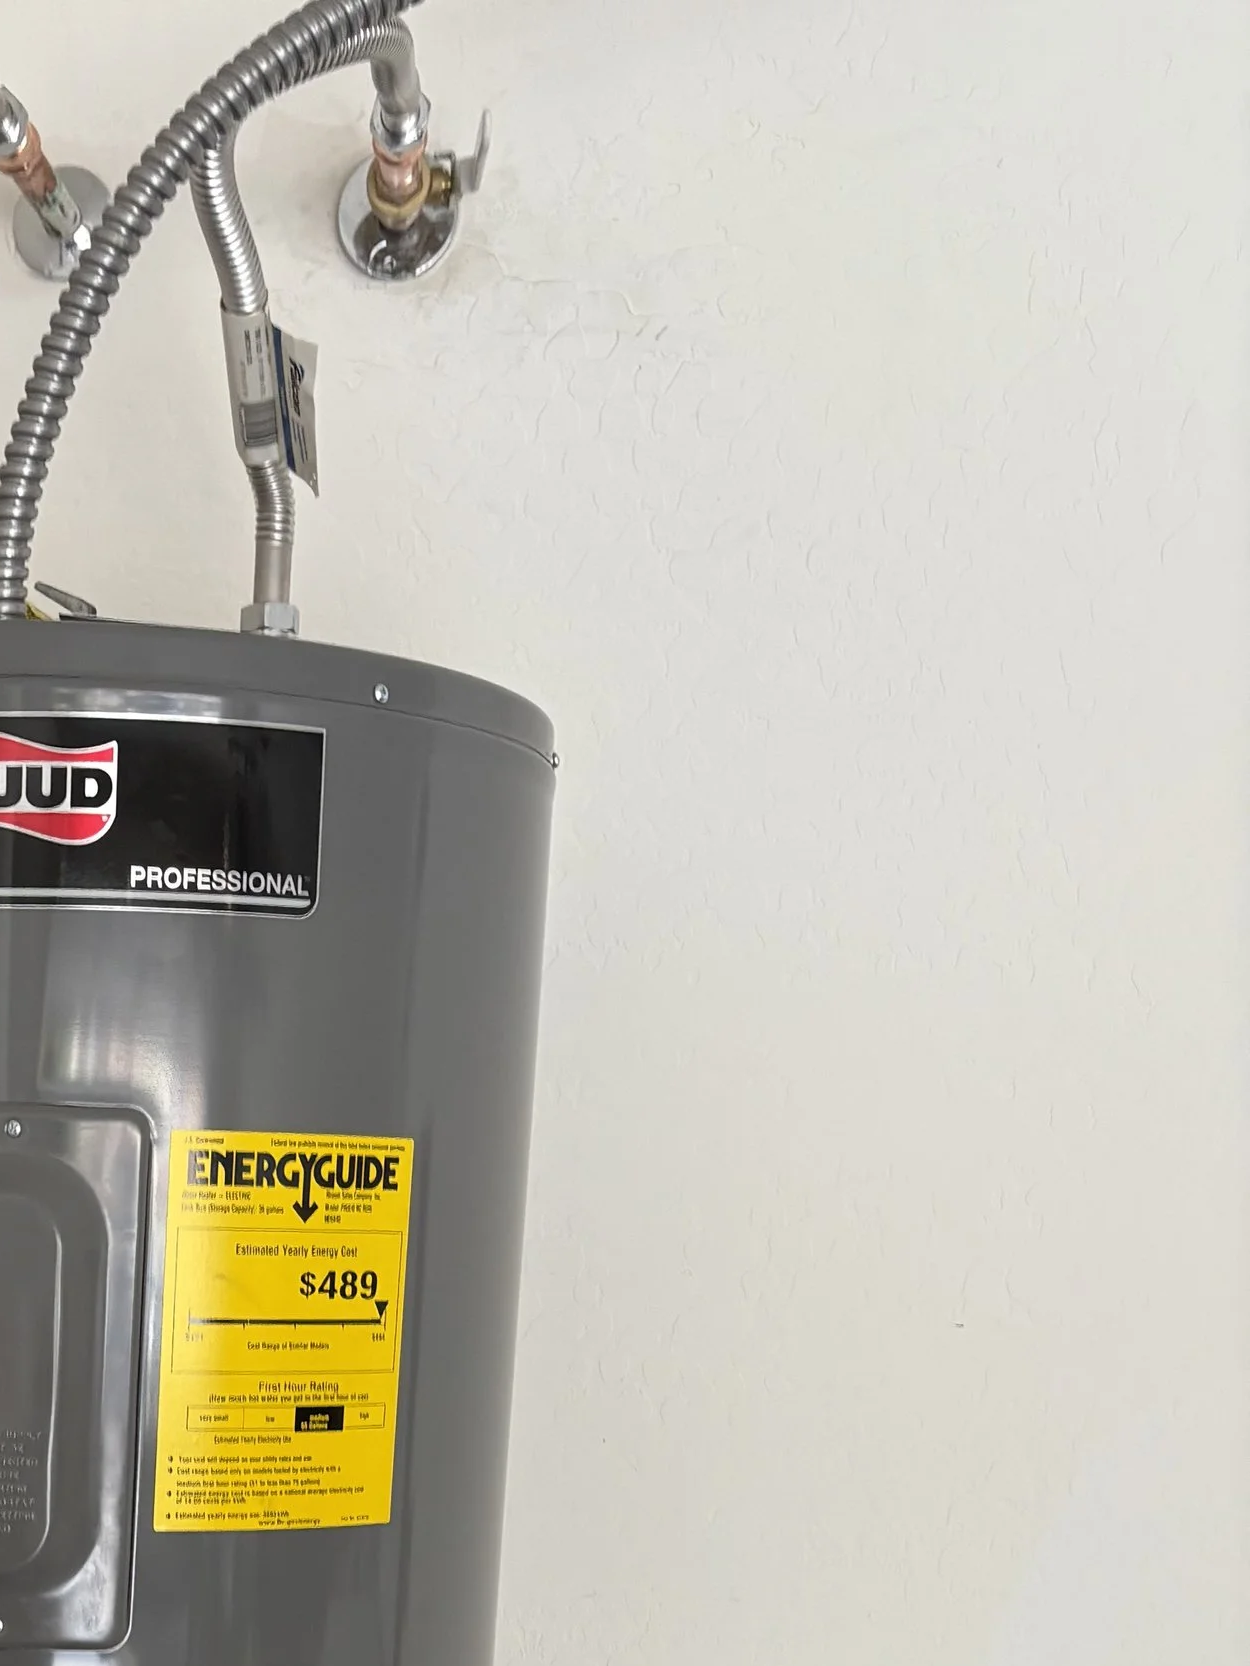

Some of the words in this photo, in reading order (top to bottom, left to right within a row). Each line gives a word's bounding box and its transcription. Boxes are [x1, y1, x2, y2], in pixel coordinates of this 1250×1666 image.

[130, 865, 309, 896] PROFESSIONAL
[187, 1149, 399, 1191] ENERGYGUIDE
[236, 1243, 279, 1256] Estimated
[282, 1244, 308, 1258] Yearly
[311, 1244, 338, 1259] Energy
[341, 1245, 358, 1257] Cost
[299, 1270, 378, 1300] $489
[258, 1381, 281, 1392] First
[284, 1381, 307, 1392] Hour
[310, 1381, 339, 1394] Rating
